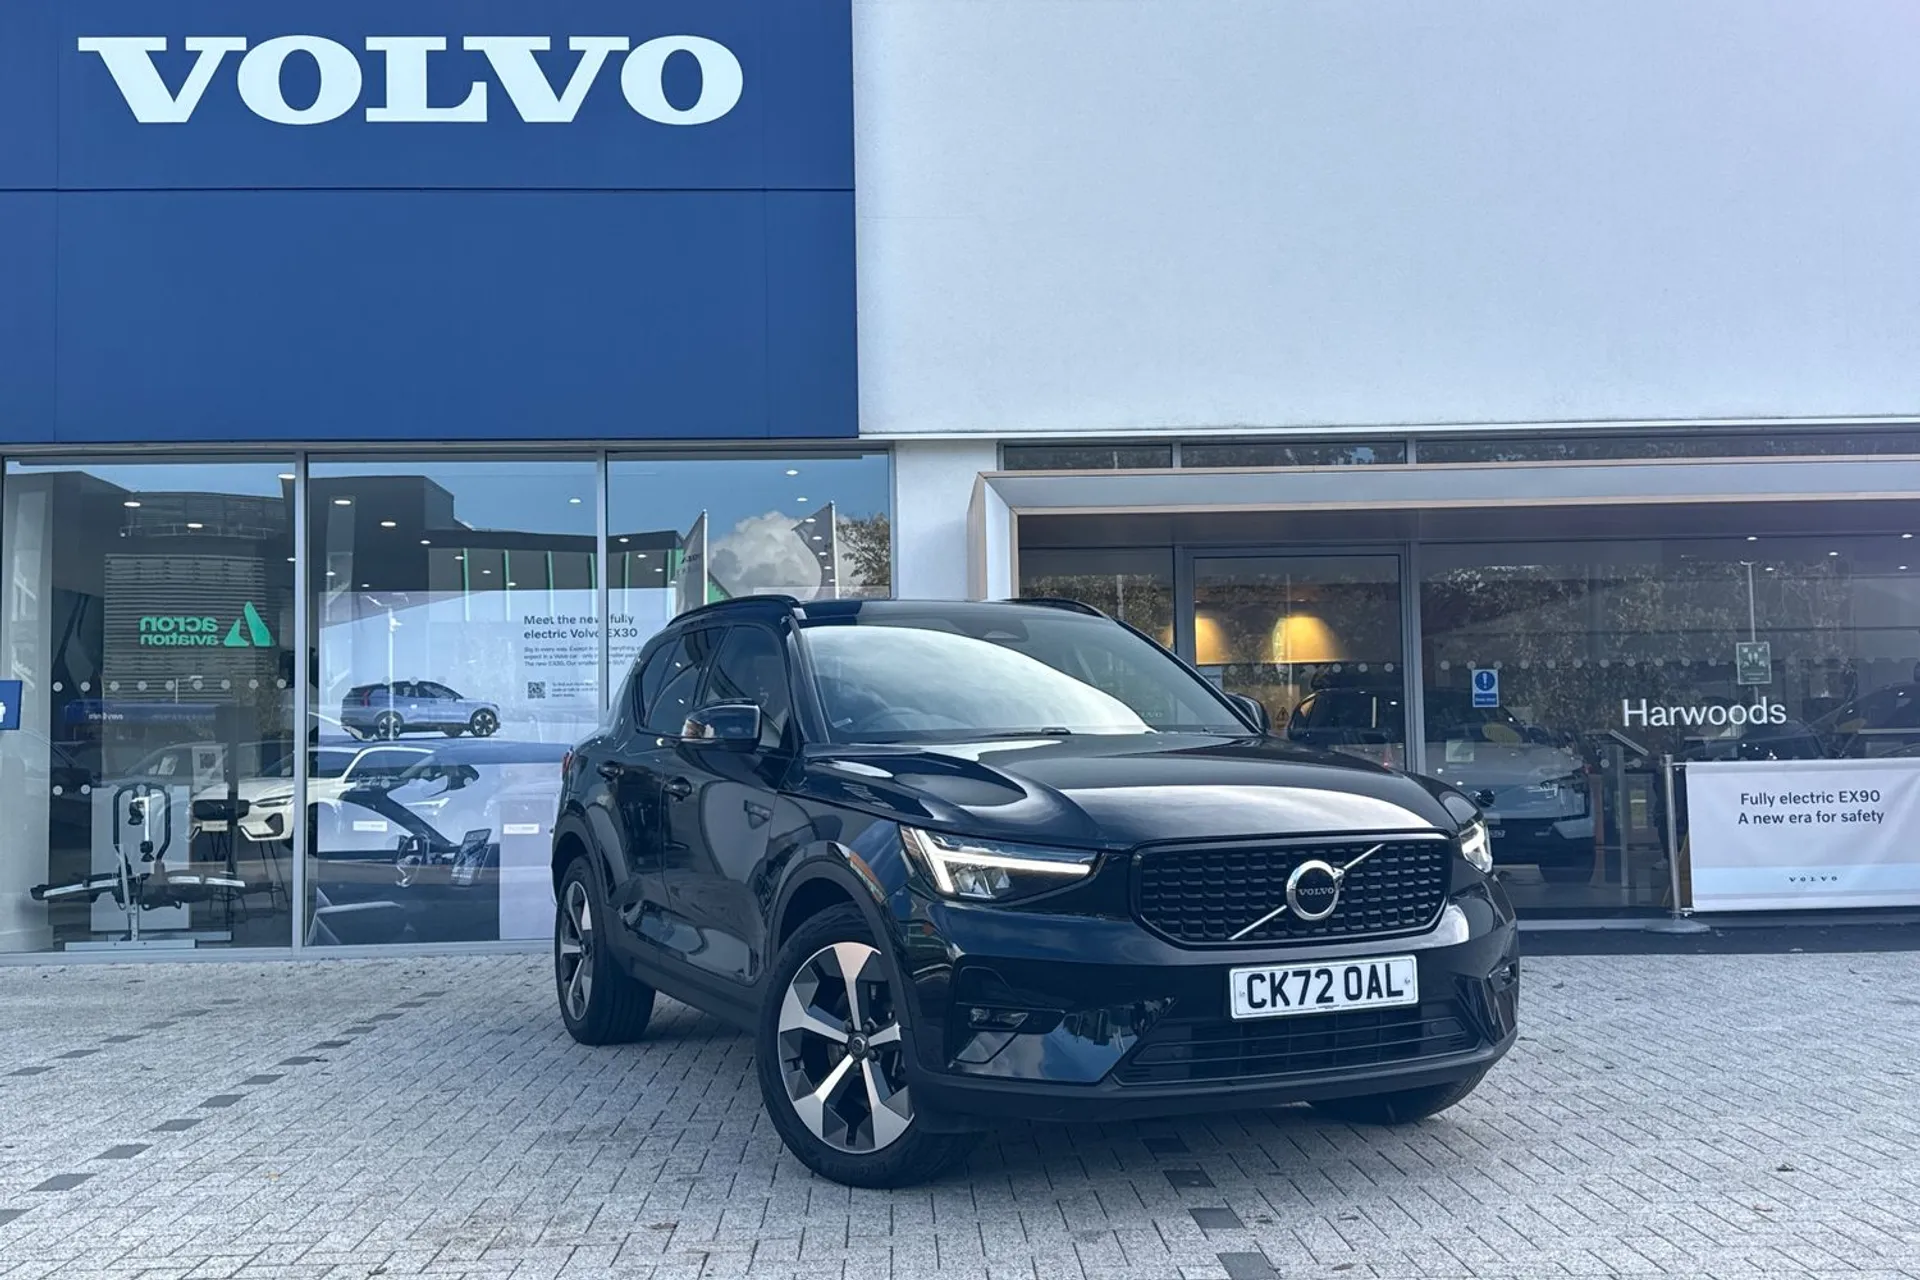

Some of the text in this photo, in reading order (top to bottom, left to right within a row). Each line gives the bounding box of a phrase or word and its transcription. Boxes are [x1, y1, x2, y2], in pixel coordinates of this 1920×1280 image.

[78, 34, 744, 126] VOLVO
[523, 615, 554, 625] Meet
[557, 614, 577, 625] the
[610, 614, 634, 625] fully
[523, 629, 568, 639] electric
[1622, 696, 1788, 727] Harwoods
[1740, 789, 1881, 807] Fully electric EX90
[1738, 809, 1885, 825] A new era for safety
[1299, 886, 1335, 896] VOLVO
[1246, 962, 1404, 1009] CK72 OAL
